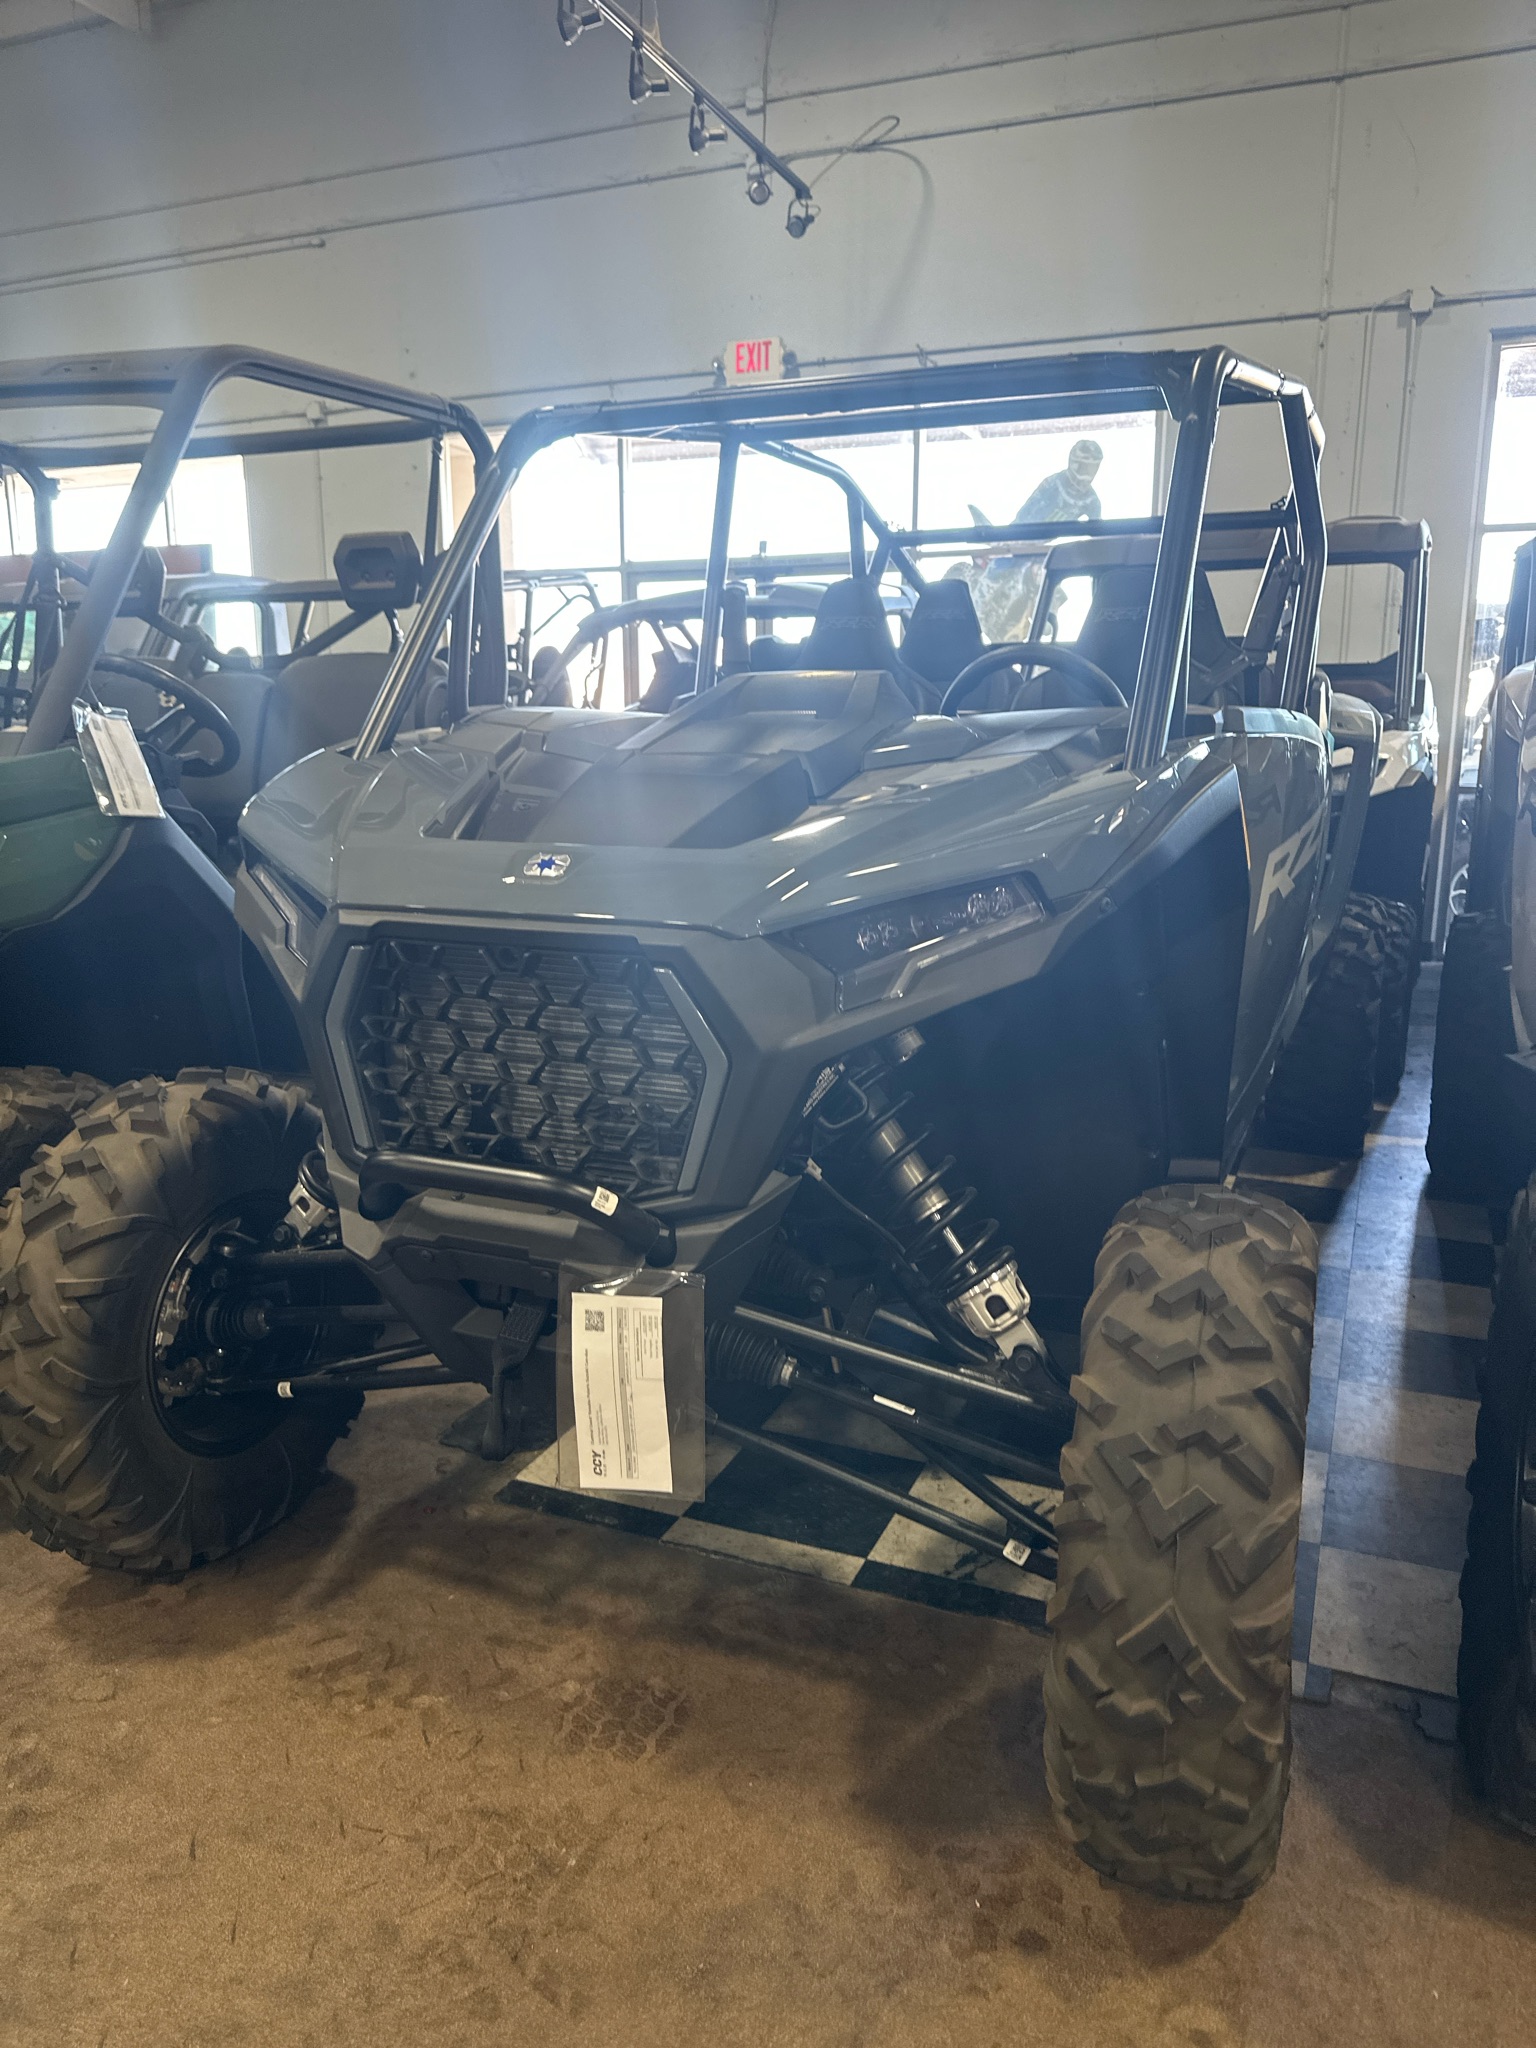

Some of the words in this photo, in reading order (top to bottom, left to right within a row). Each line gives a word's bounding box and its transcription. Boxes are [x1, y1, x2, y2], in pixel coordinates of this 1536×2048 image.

[735, 340, 772, 374] EXIT
[1253, 799, 1325, 936] RZ
[591, 1449, 602, 1477] CCY
